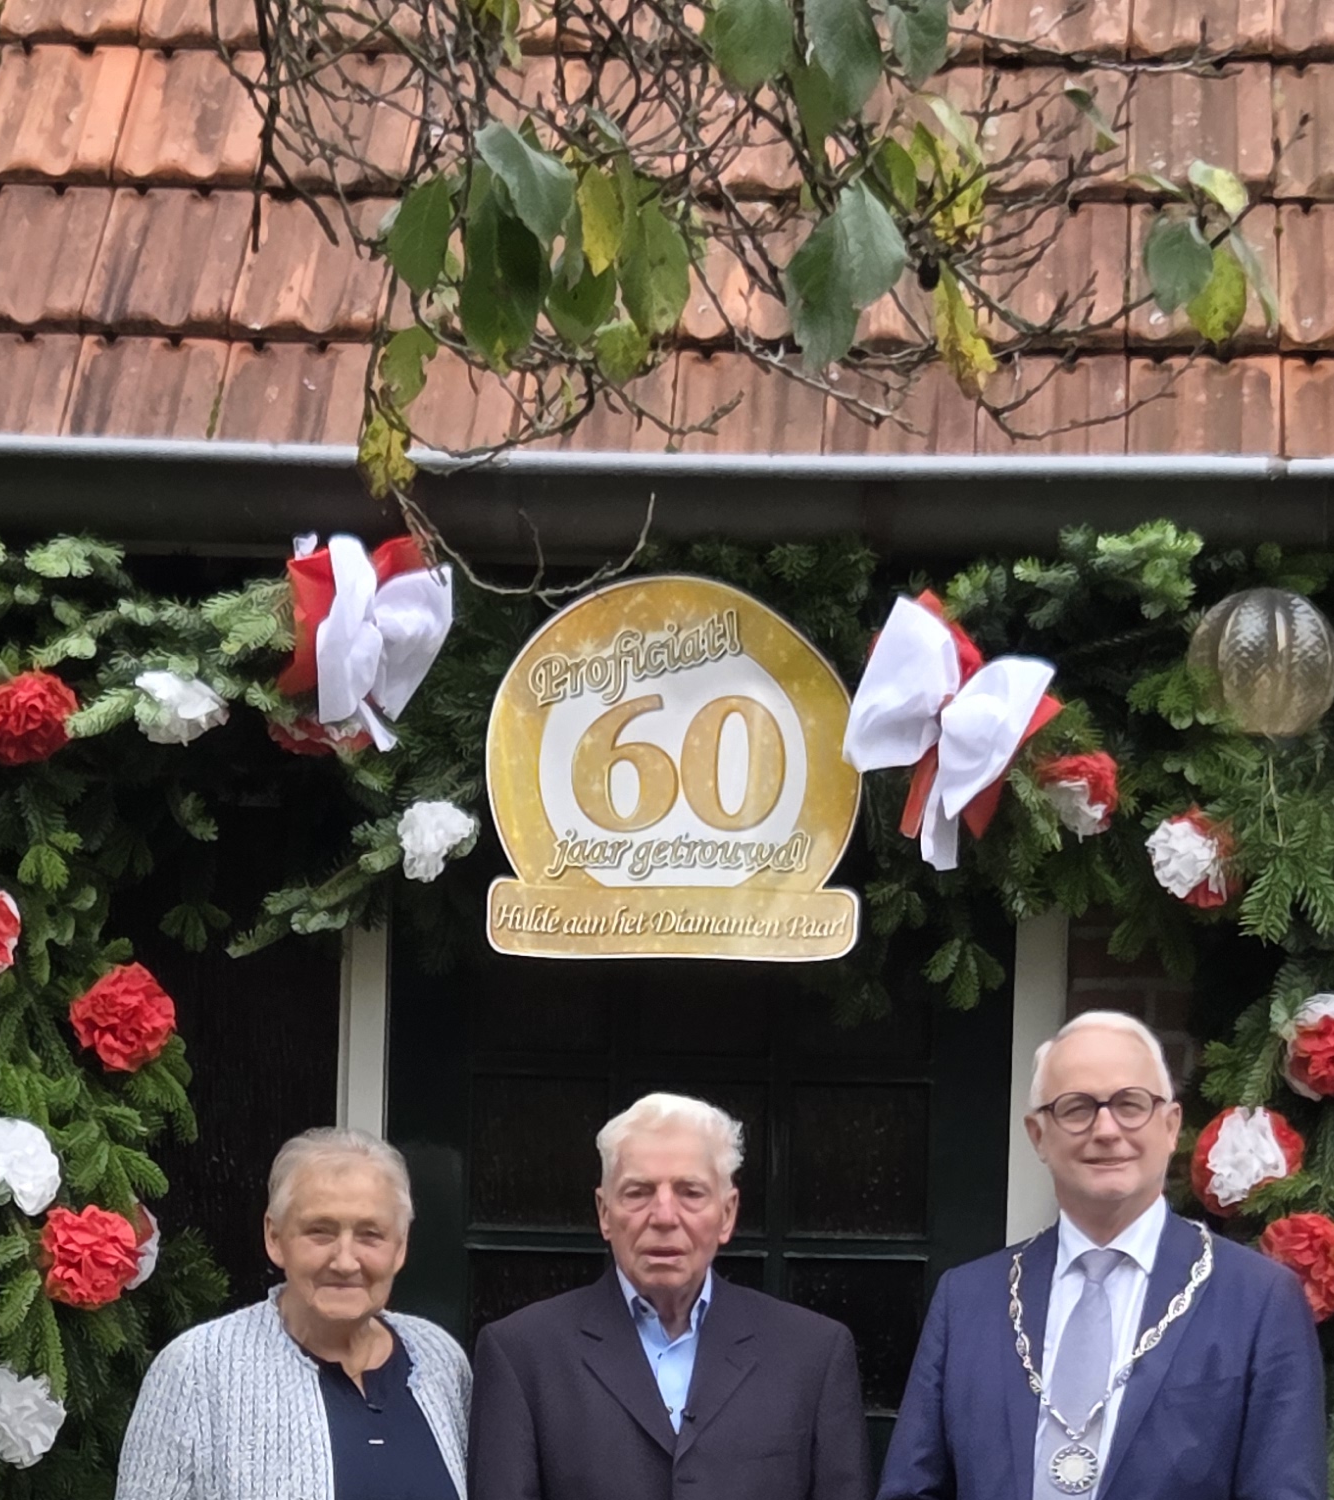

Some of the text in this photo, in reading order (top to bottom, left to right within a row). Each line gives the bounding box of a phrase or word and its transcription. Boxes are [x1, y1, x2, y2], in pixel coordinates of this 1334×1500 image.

[530, 610, 743, 706] Proficiat!
[571, 694, 787, 832] 60
[546, 829, 812, 879] jaar getrouwd!
[496, 904, 849, 940] Hulde aan het Diamanten Paar!
